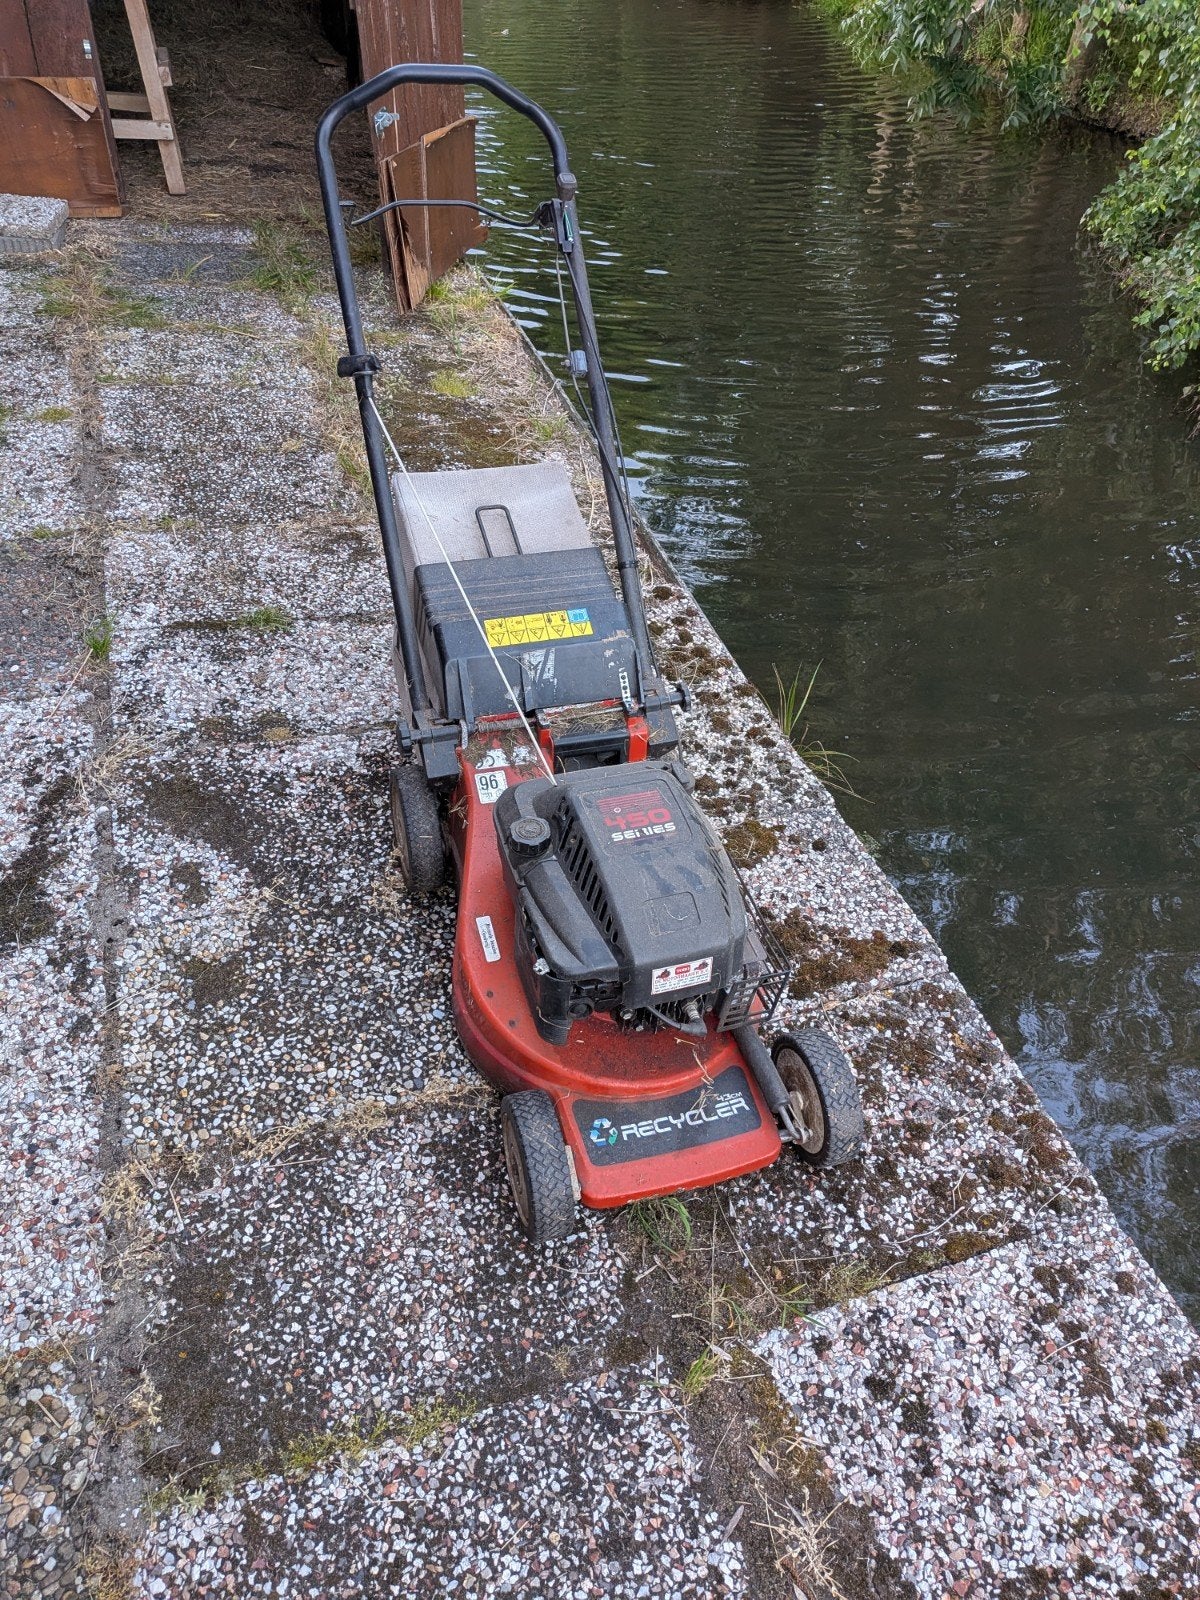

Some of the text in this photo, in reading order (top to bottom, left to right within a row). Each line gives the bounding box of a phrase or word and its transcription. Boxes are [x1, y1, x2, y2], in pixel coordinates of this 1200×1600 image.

[479, 774, 498, 791] 96
[604, 808, 671, 830] 450
[620, 1098, 750, 1140] RECYCLER
